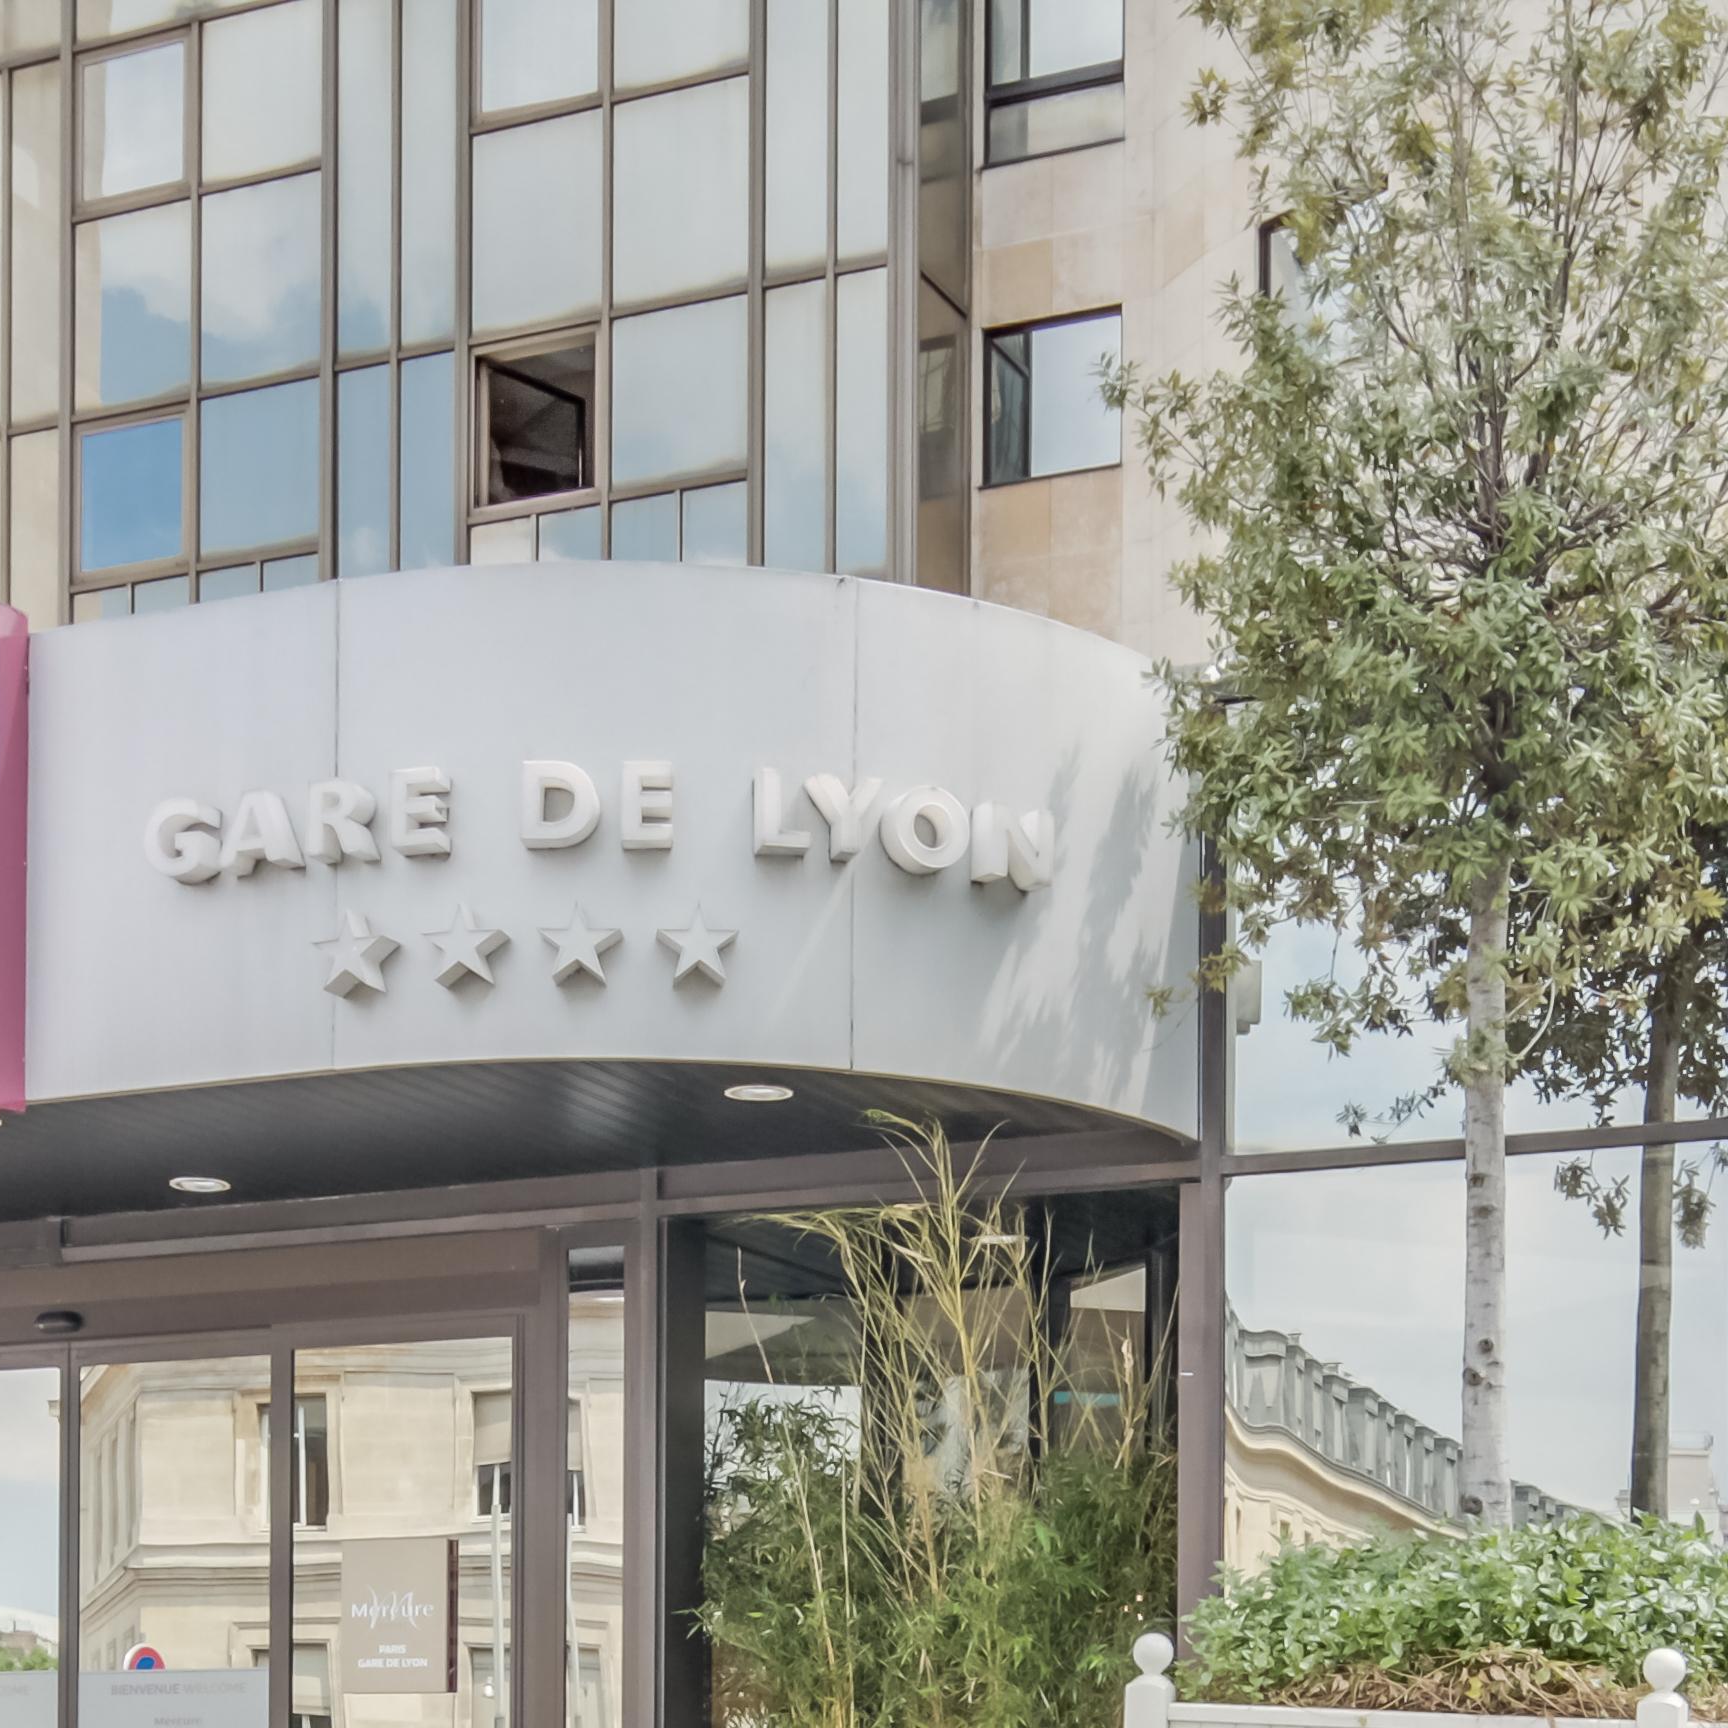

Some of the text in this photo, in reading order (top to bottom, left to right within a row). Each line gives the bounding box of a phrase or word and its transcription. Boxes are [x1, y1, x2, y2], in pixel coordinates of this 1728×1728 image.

[143, 759, 1055, 893] GARE DE LYON
[357, 1657, 428, 1668] GARE DE LYON
[111, 1683, 180, 1696] BIENVENUE
